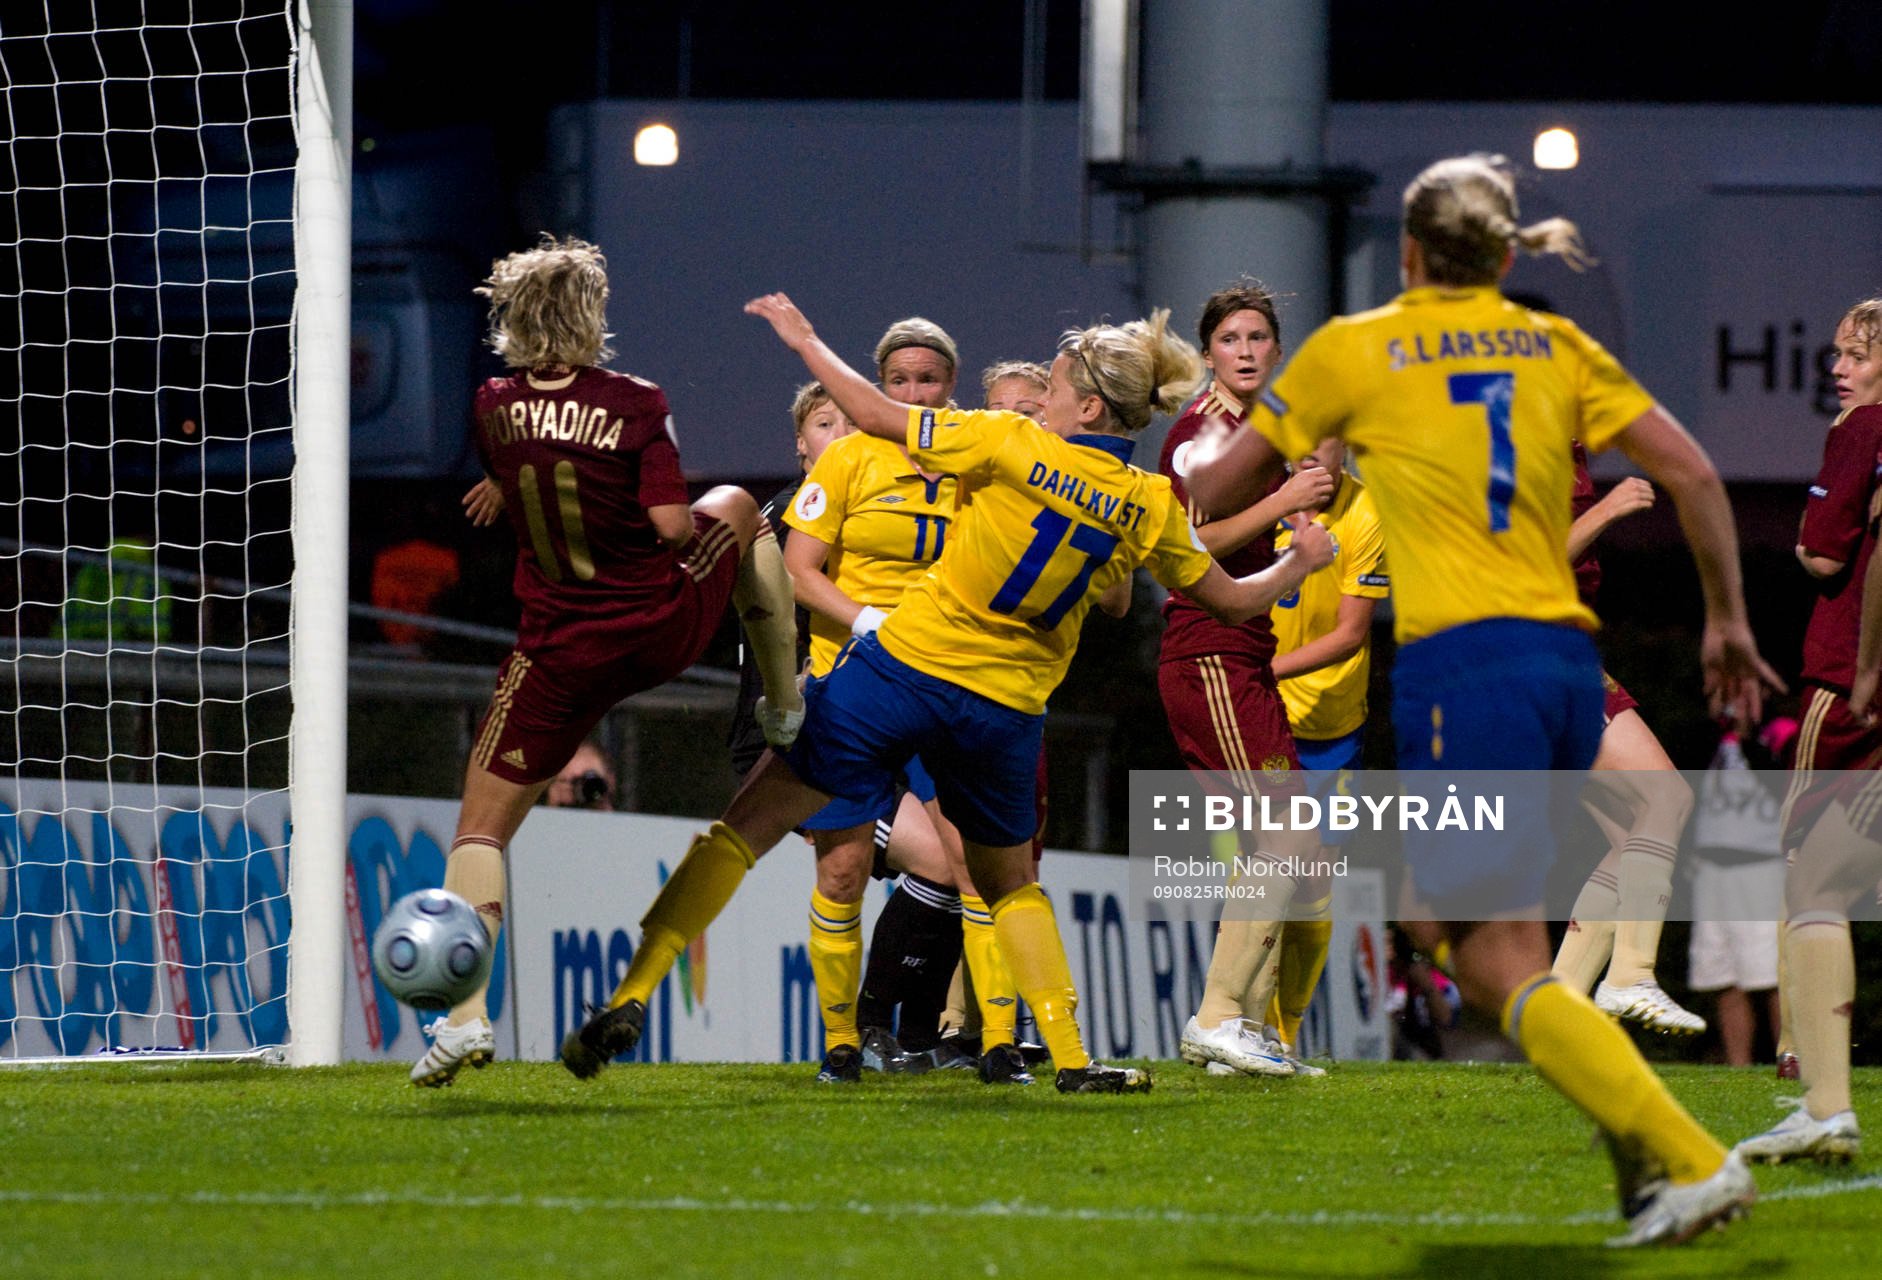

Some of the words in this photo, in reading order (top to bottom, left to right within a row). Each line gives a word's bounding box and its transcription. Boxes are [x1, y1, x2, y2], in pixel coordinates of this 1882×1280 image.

[1448, 371, 1515, 532] 7
[518, 462, 596, 581] 11
[912, 513, 946, 561] 11
[989, 505, 1121, 632] 17
